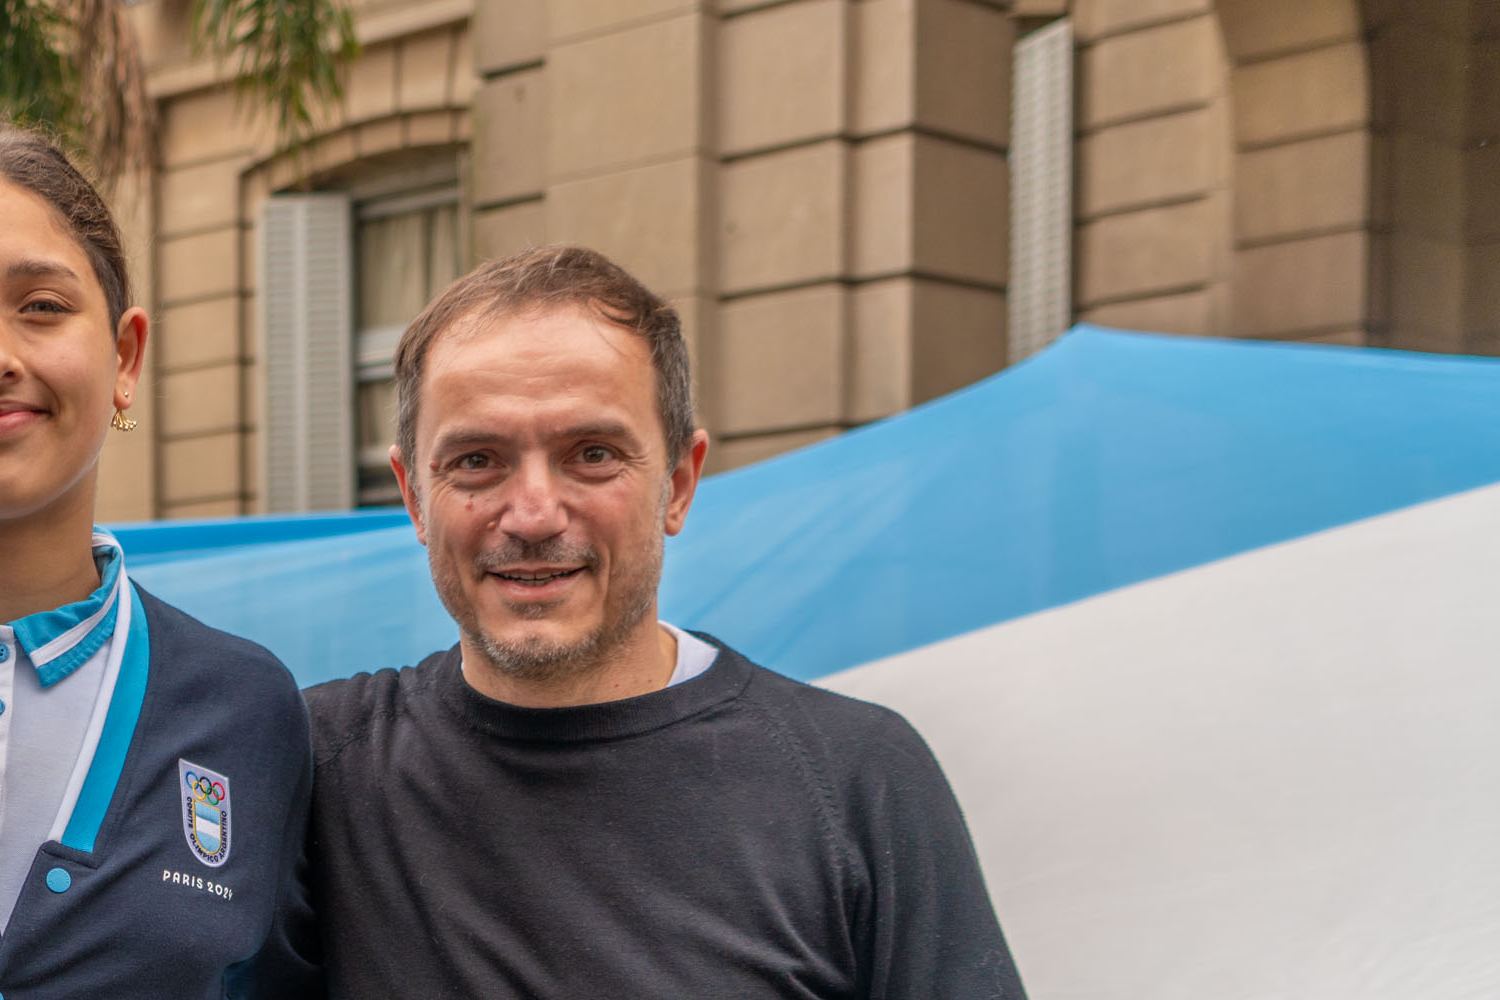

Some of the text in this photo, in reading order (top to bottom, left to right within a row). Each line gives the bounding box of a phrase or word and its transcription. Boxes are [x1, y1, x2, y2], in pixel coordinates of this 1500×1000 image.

[190, 833, 219, 863] OLIMPICO
[162, 870, 233, 901] PARIS 2024
